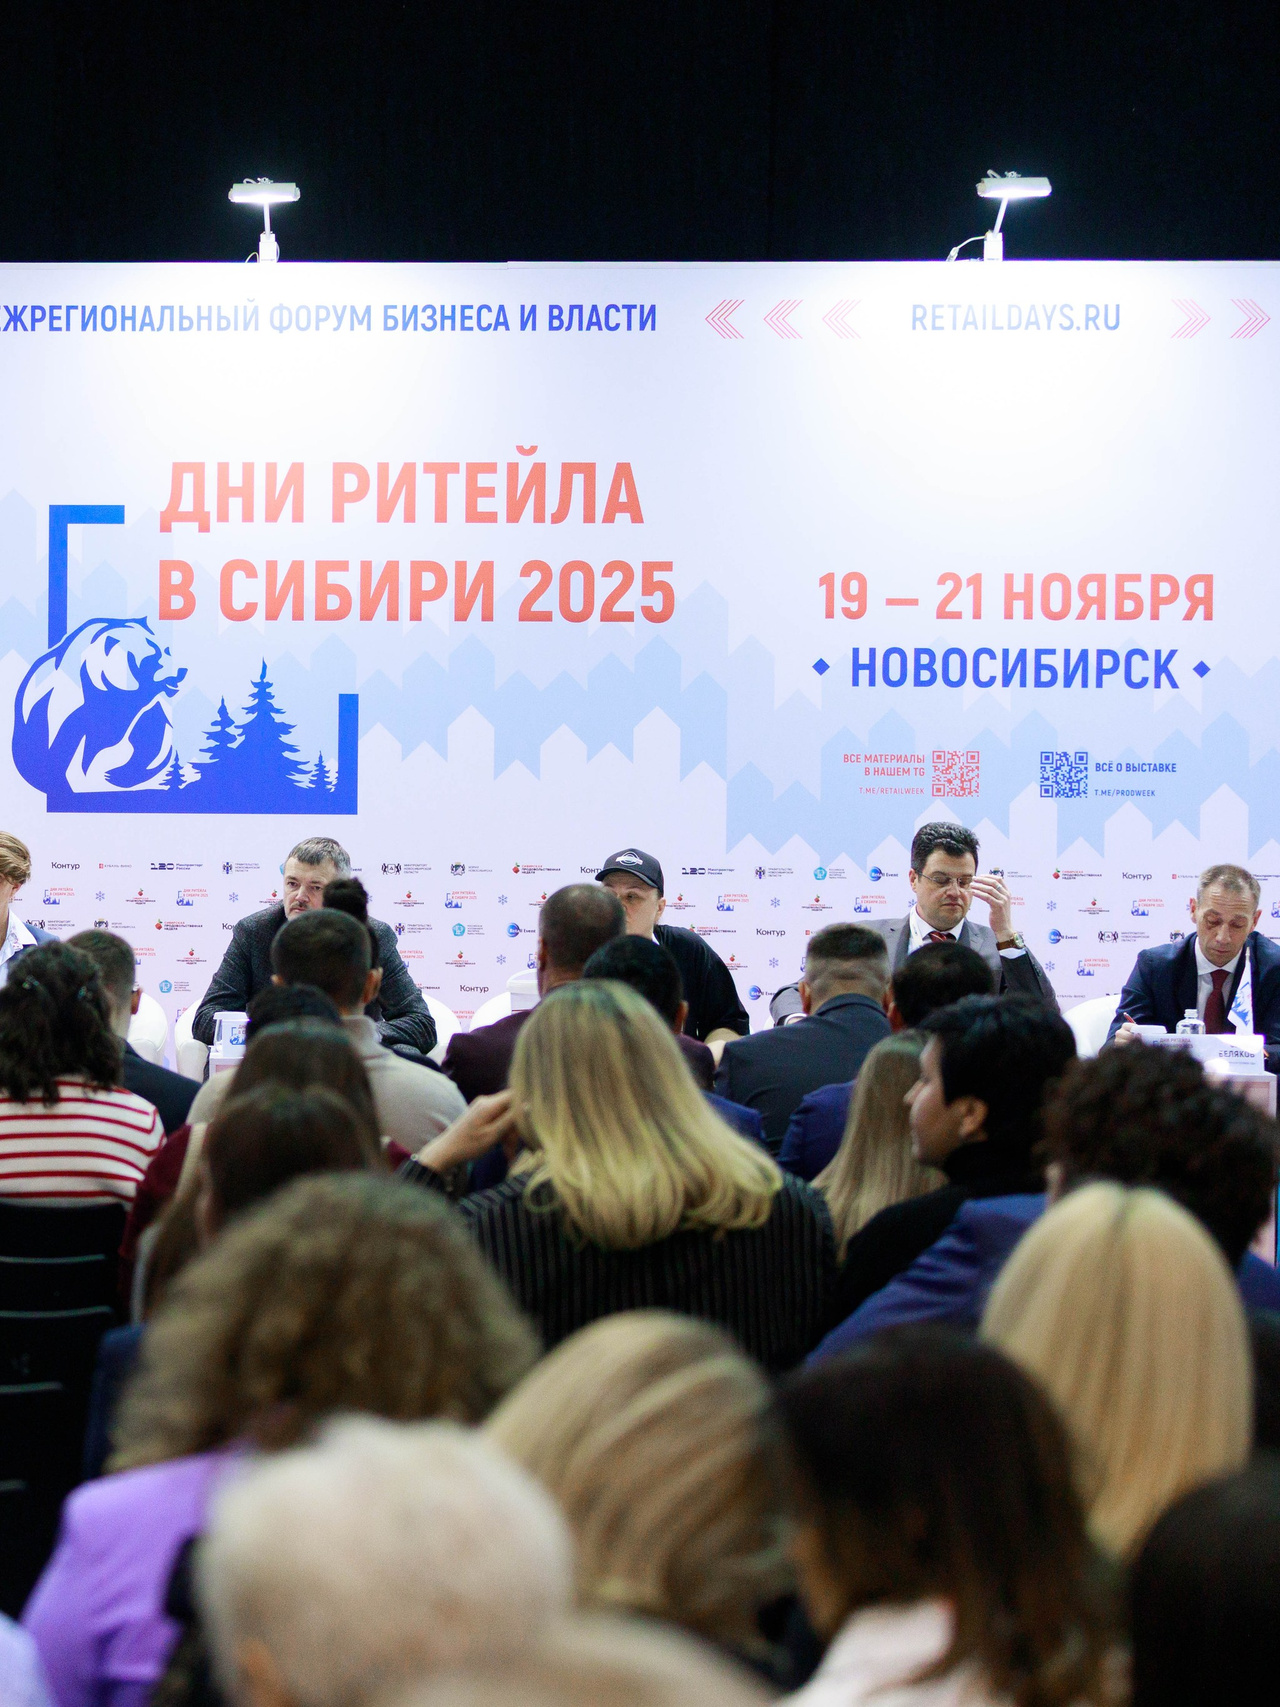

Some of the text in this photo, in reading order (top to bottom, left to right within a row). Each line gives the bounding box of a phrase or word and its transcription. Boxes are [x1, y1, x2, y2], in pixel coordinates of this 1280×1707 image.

[269, 303, 372, 333] ФОРУМ
[384, 304, 510, 332] БИЗНЕСА
[520, 304, 536, 332] И
[548, 304, 656, 332] ВЛАСТИ
[912, 303, 1121, 332] RETAILDAYS.RU
[160, 444, 644, 534] ДНИ РИТЕЙЛА
[158, 558, 674, 624] В СИБИРИ 2025
[818, 572, 868, 620] 19
[936, 572, 982, 620] 21
[1004, 572, 1214, 622] НОЯБРЯ
[852, 646, 1180, 690] НОВОСИБИРСК
[844, 754, 924, 764] ВСЕ МАТЕРИАЛЫ
[864, 766, 870, 776] В
[874, 766, 910, 776] НАШЕМ
[1094, 761, 1113, 773] ВСЁ
[1126, 762, 1176, 772] ВЫСТАВКЕ
[859, 787, 925, 795] T.ME/RETAILWEEK
